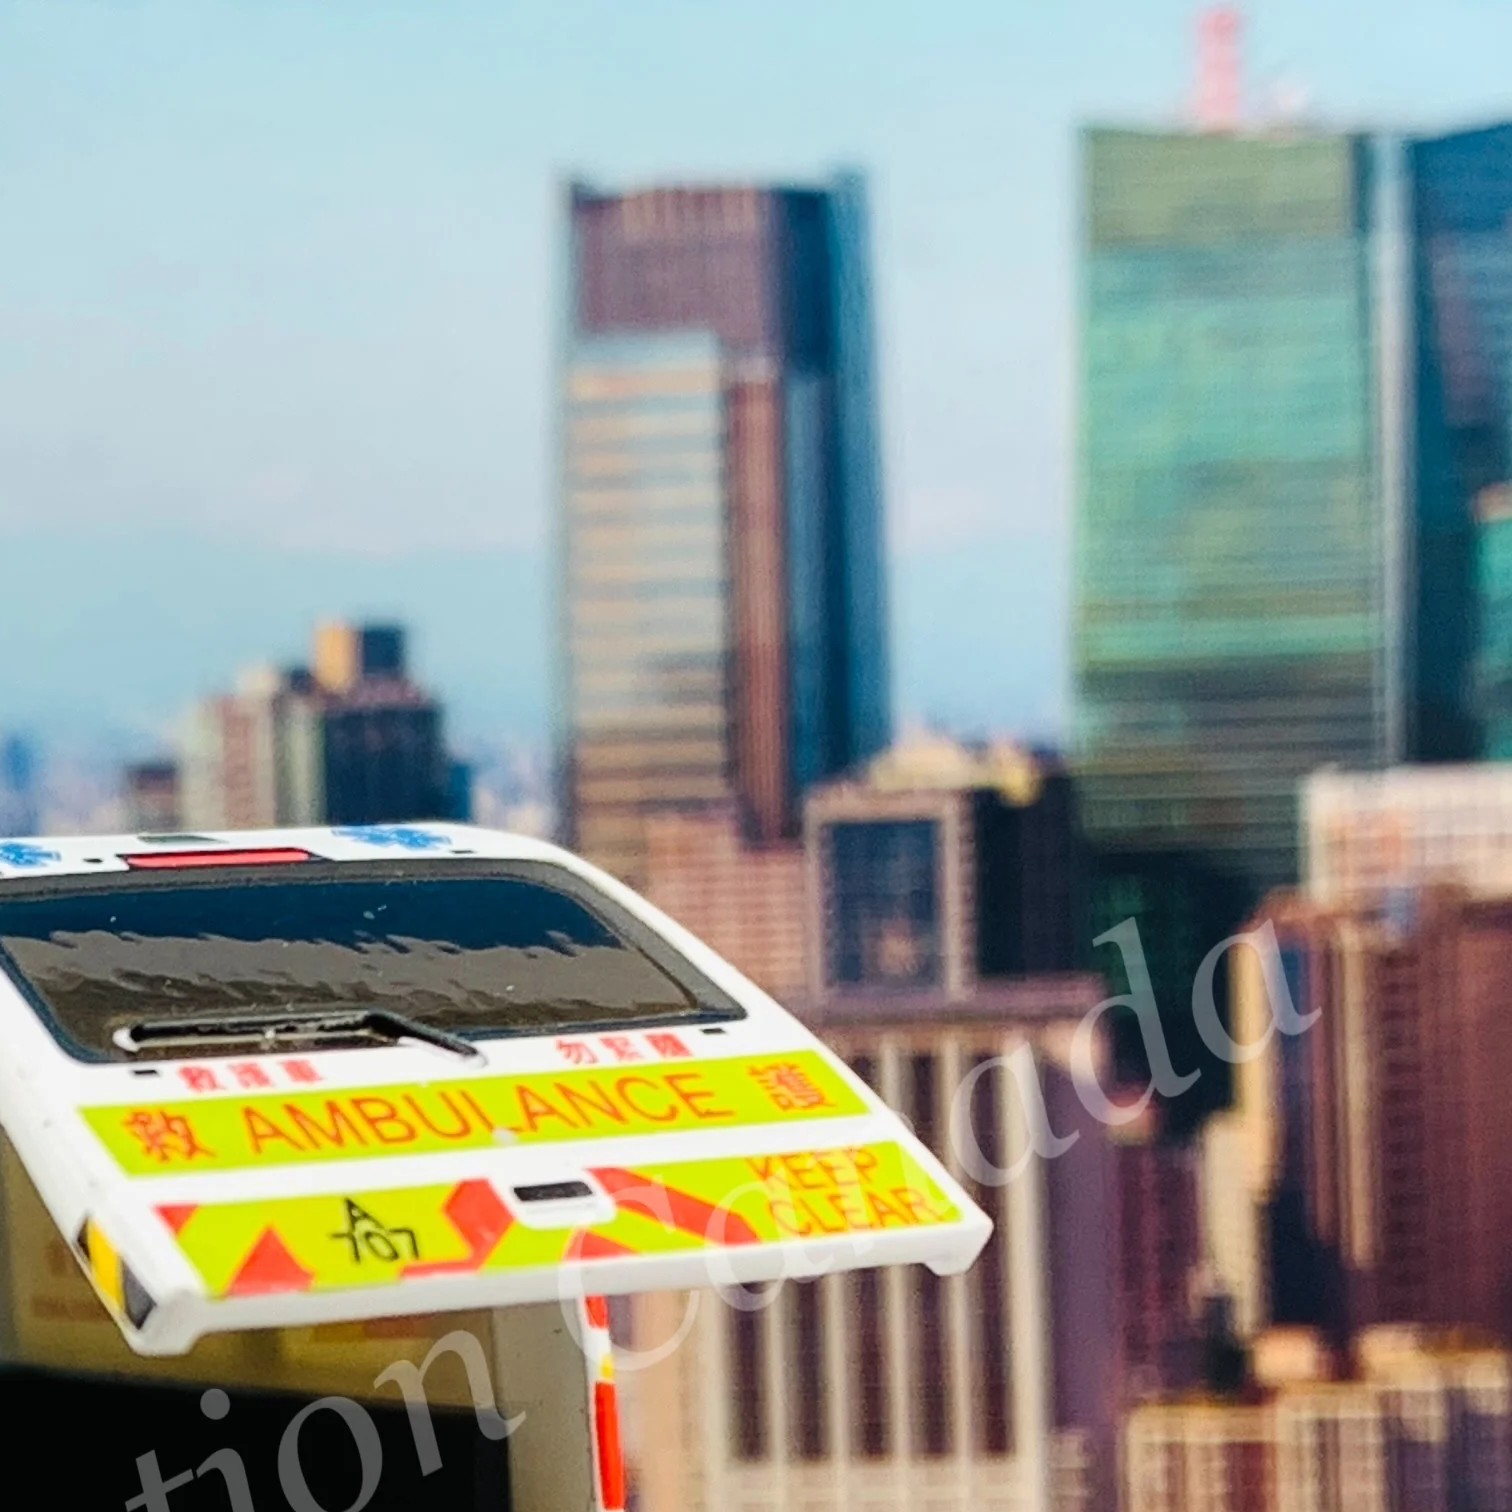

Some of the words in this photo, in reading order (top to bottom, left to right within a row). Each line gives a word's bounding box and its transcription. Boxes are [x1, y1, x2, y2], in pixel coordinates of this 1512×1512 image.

[240, 1072, 735, 1156] AMBULANCE
[745, 1145, 879, 1192] KEEP
[768, 1186, 946, 1237] CLEAR
